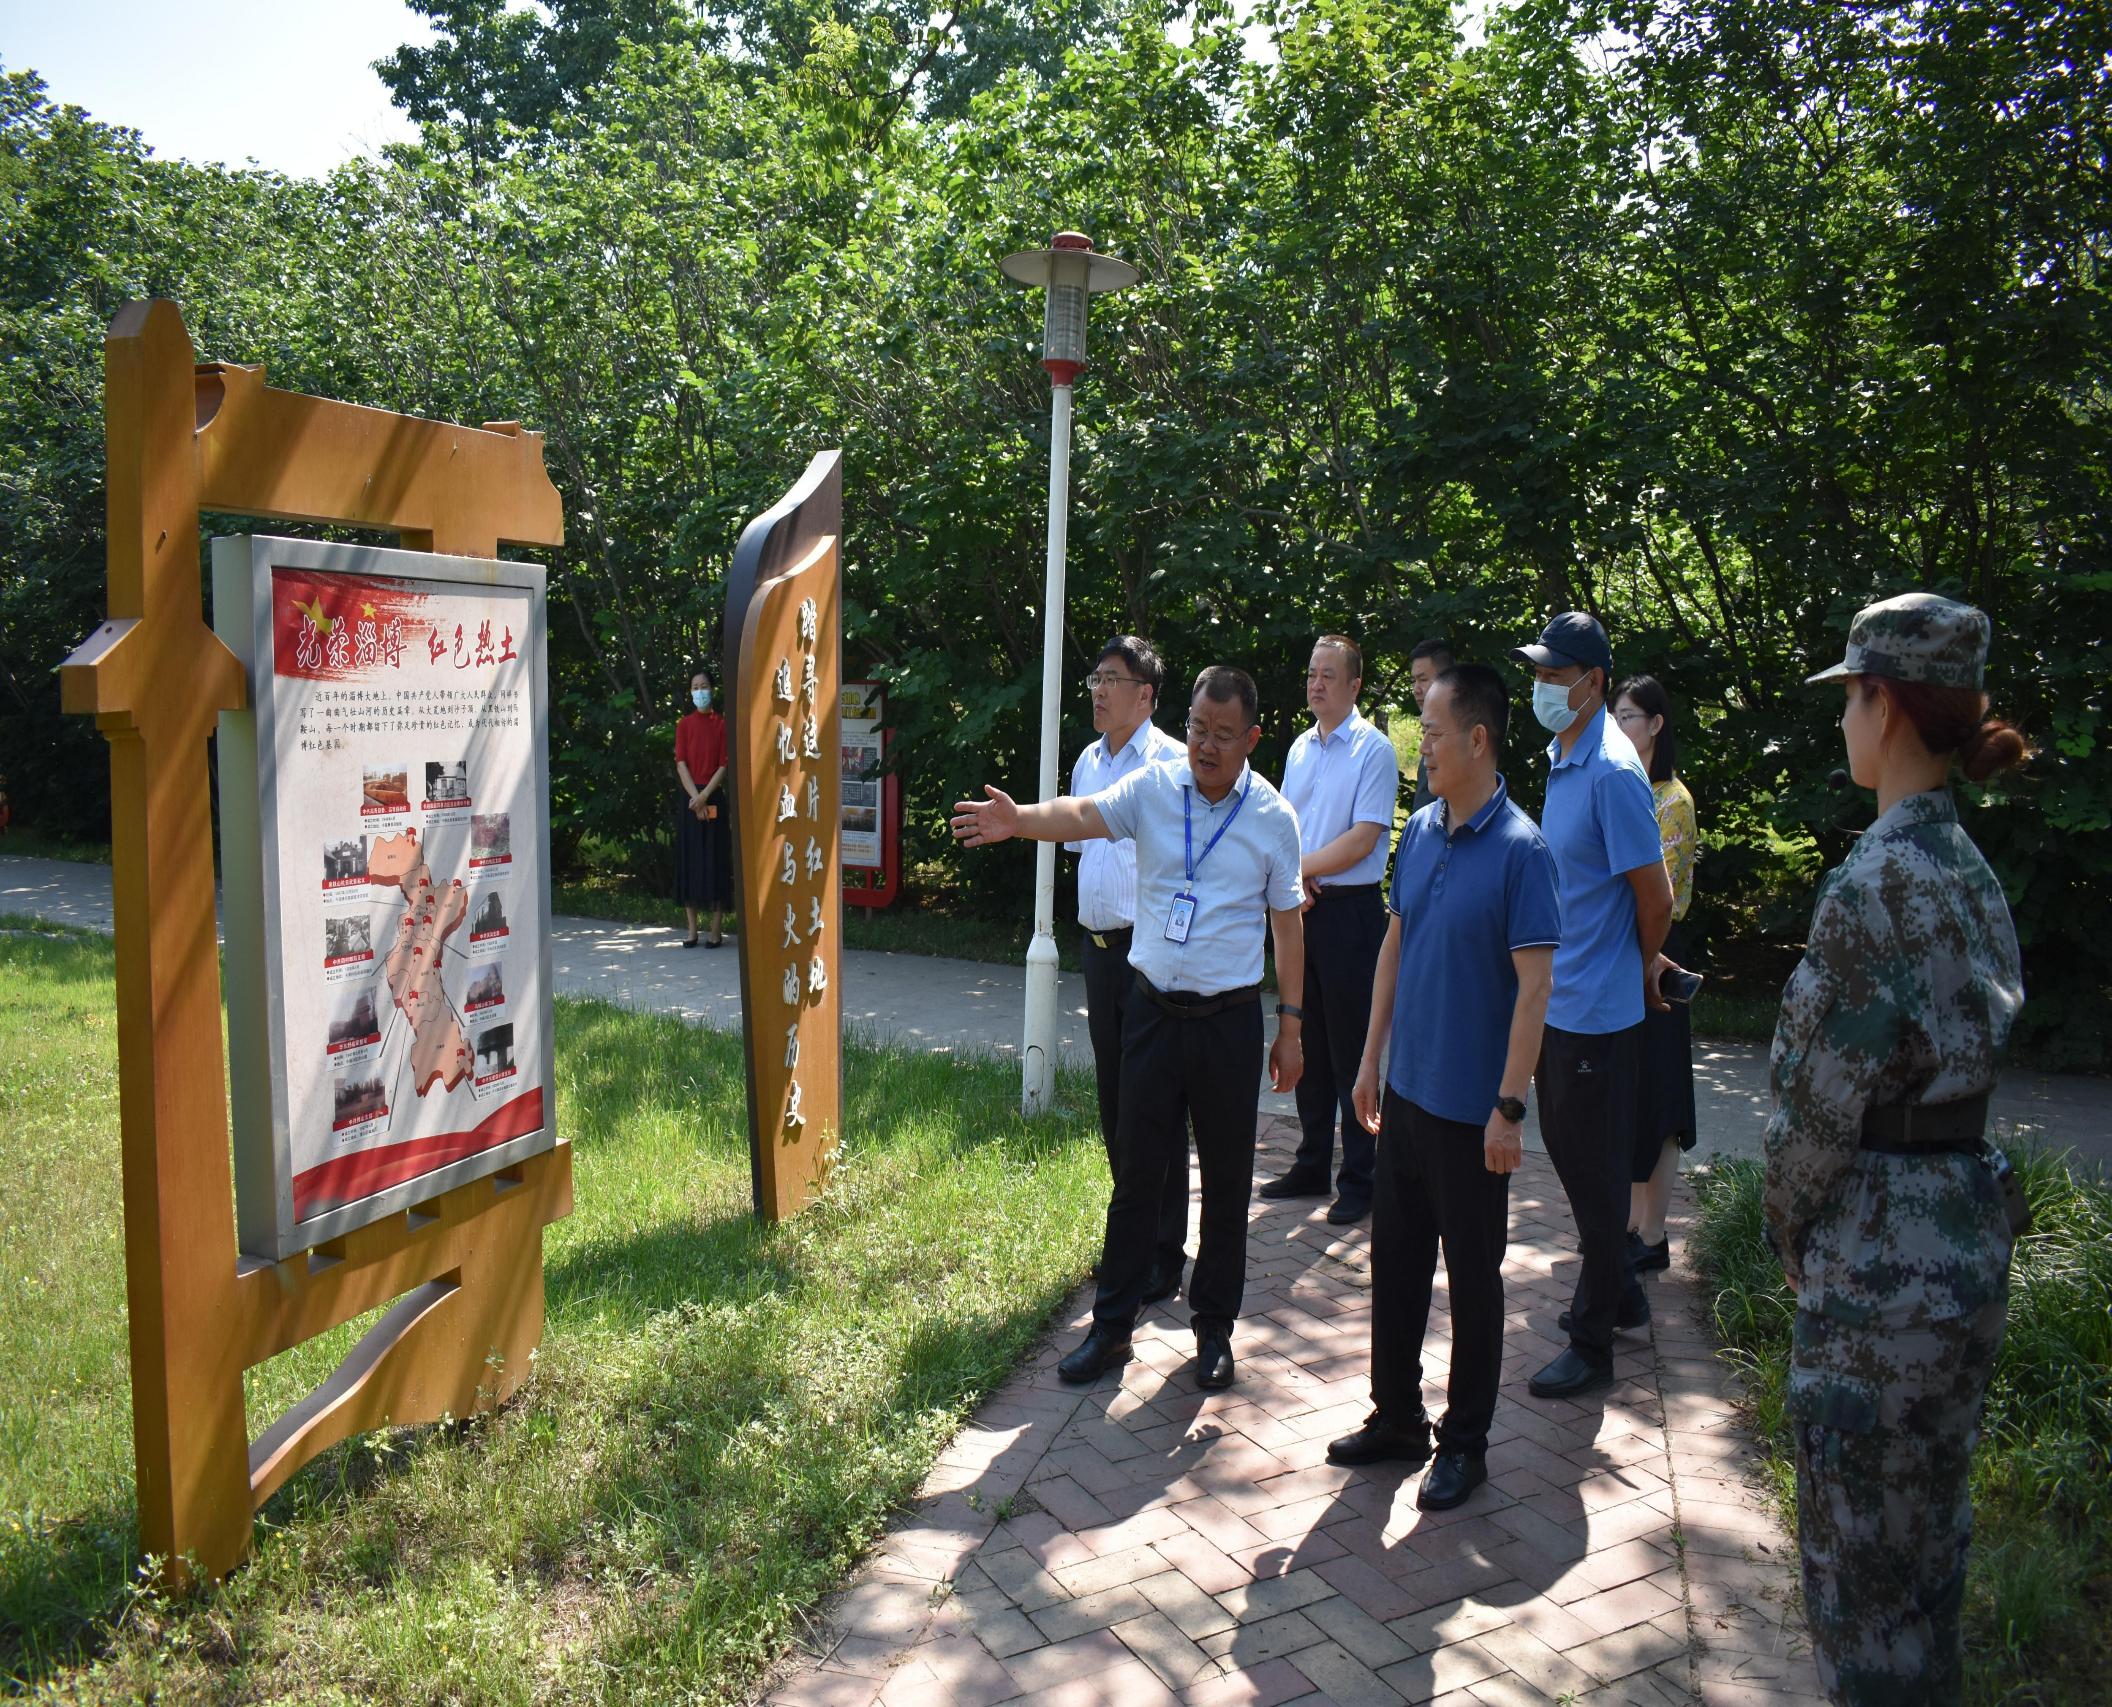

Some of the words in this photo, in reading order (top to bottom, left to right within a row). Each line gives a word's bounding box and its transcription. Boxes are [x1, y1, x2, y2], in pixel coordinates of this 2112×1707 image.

[297, 614, 407, 669] 光荣淄博
[428, 619, 517, 669] 红色热土
[800, 597, 828, 991] 踏寻这片红土地
[776, 657, 806, 1127] 追忆血与火的历史
